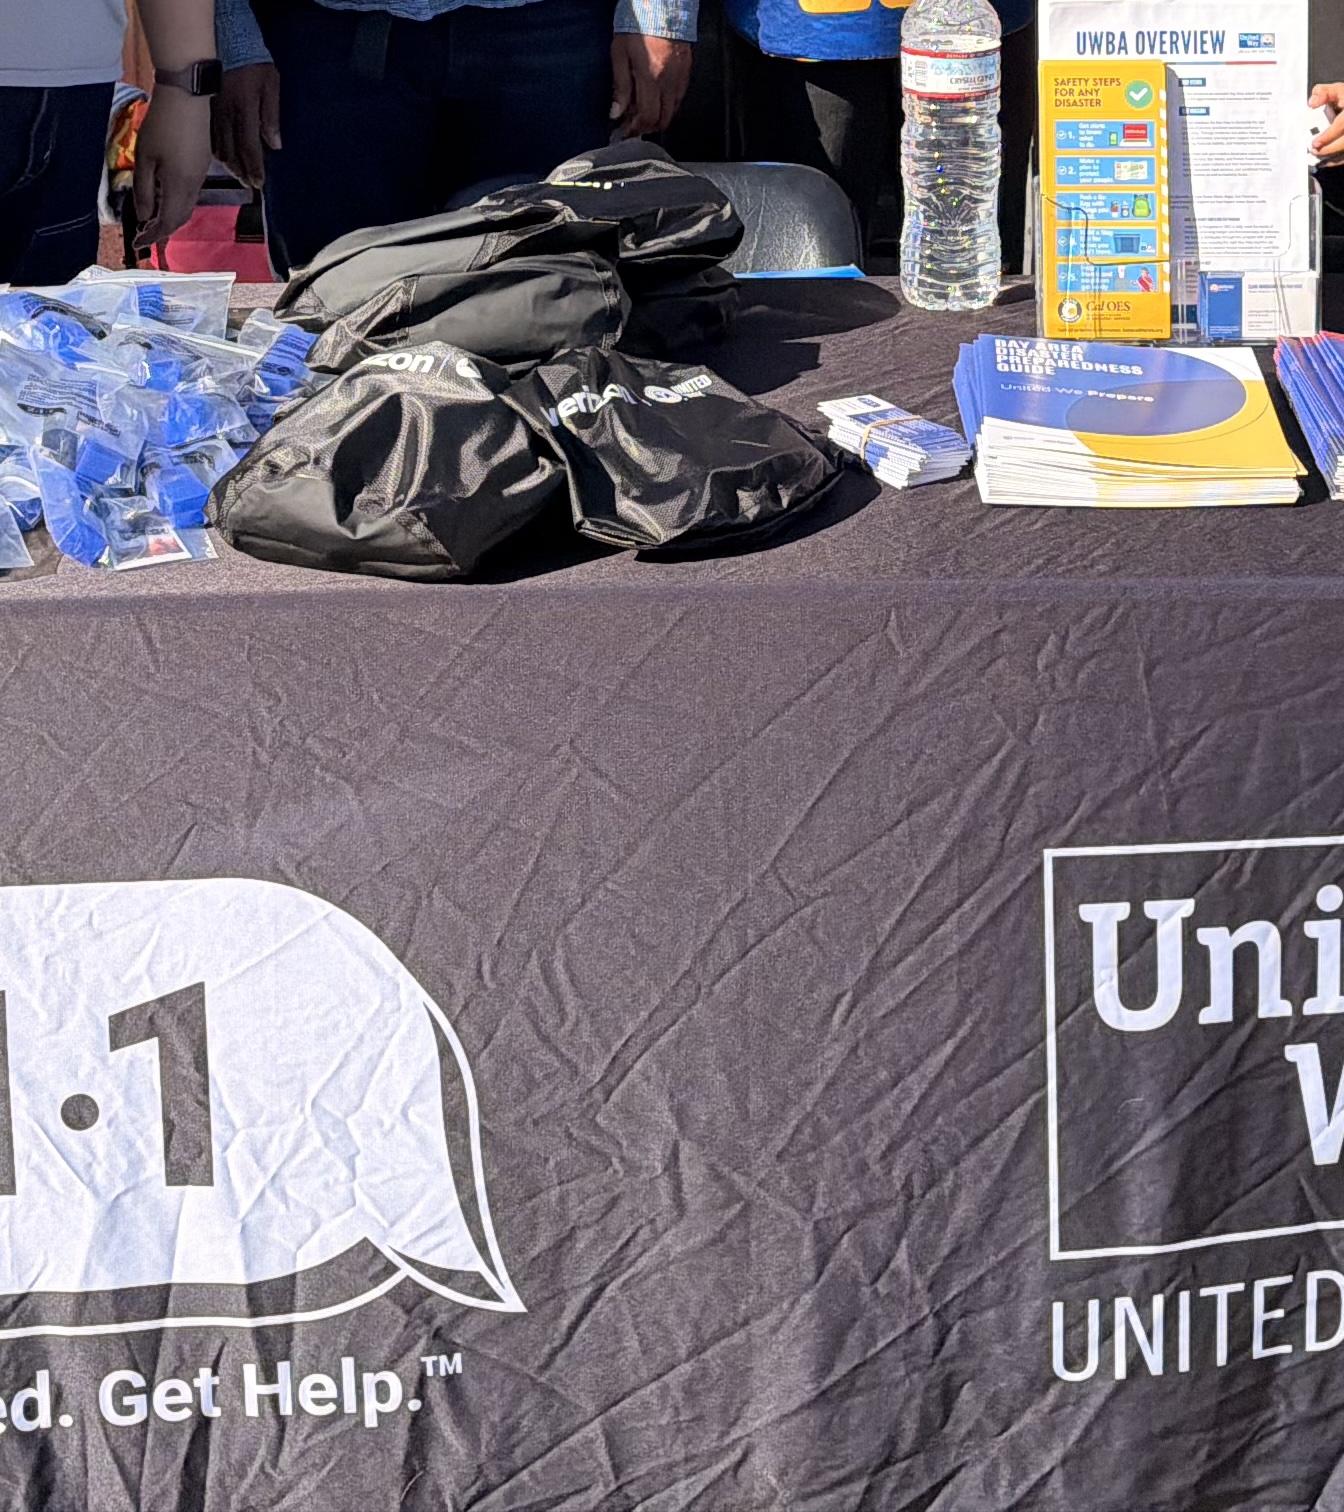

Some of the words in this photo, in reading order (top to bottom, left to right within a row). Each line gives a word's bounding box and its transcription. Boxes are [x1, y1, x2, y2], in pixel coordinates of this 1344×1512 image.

[1076, 30, 1129, 56] UWBA
[1135, 29, 1226, 55] OVERVIEW
[1053, 77, 1090, 87] SAFETY
[1092, 77, 1122, 87] STEPS
[1054, 87, 1075, 97] FOR
[1077, 87, 1101, 97] ANY
[1054, 98, 1102, 108] DISASTER
[1106, 300, 1131, 312] OES
[995, 346, 1084, 362] DISASTER
[1035, 342, 1084, 355] AREA
[996, 354, 1144, 376] PREPAREDNESS
[996, 363, 1056, 376] GUIDE
[1000, 383, 1051, 393] United
[1055, 386, 1083, 396] We
[1087, 389, 1155, 403] Prepare
[98, 1367, 222, 1427] Get
